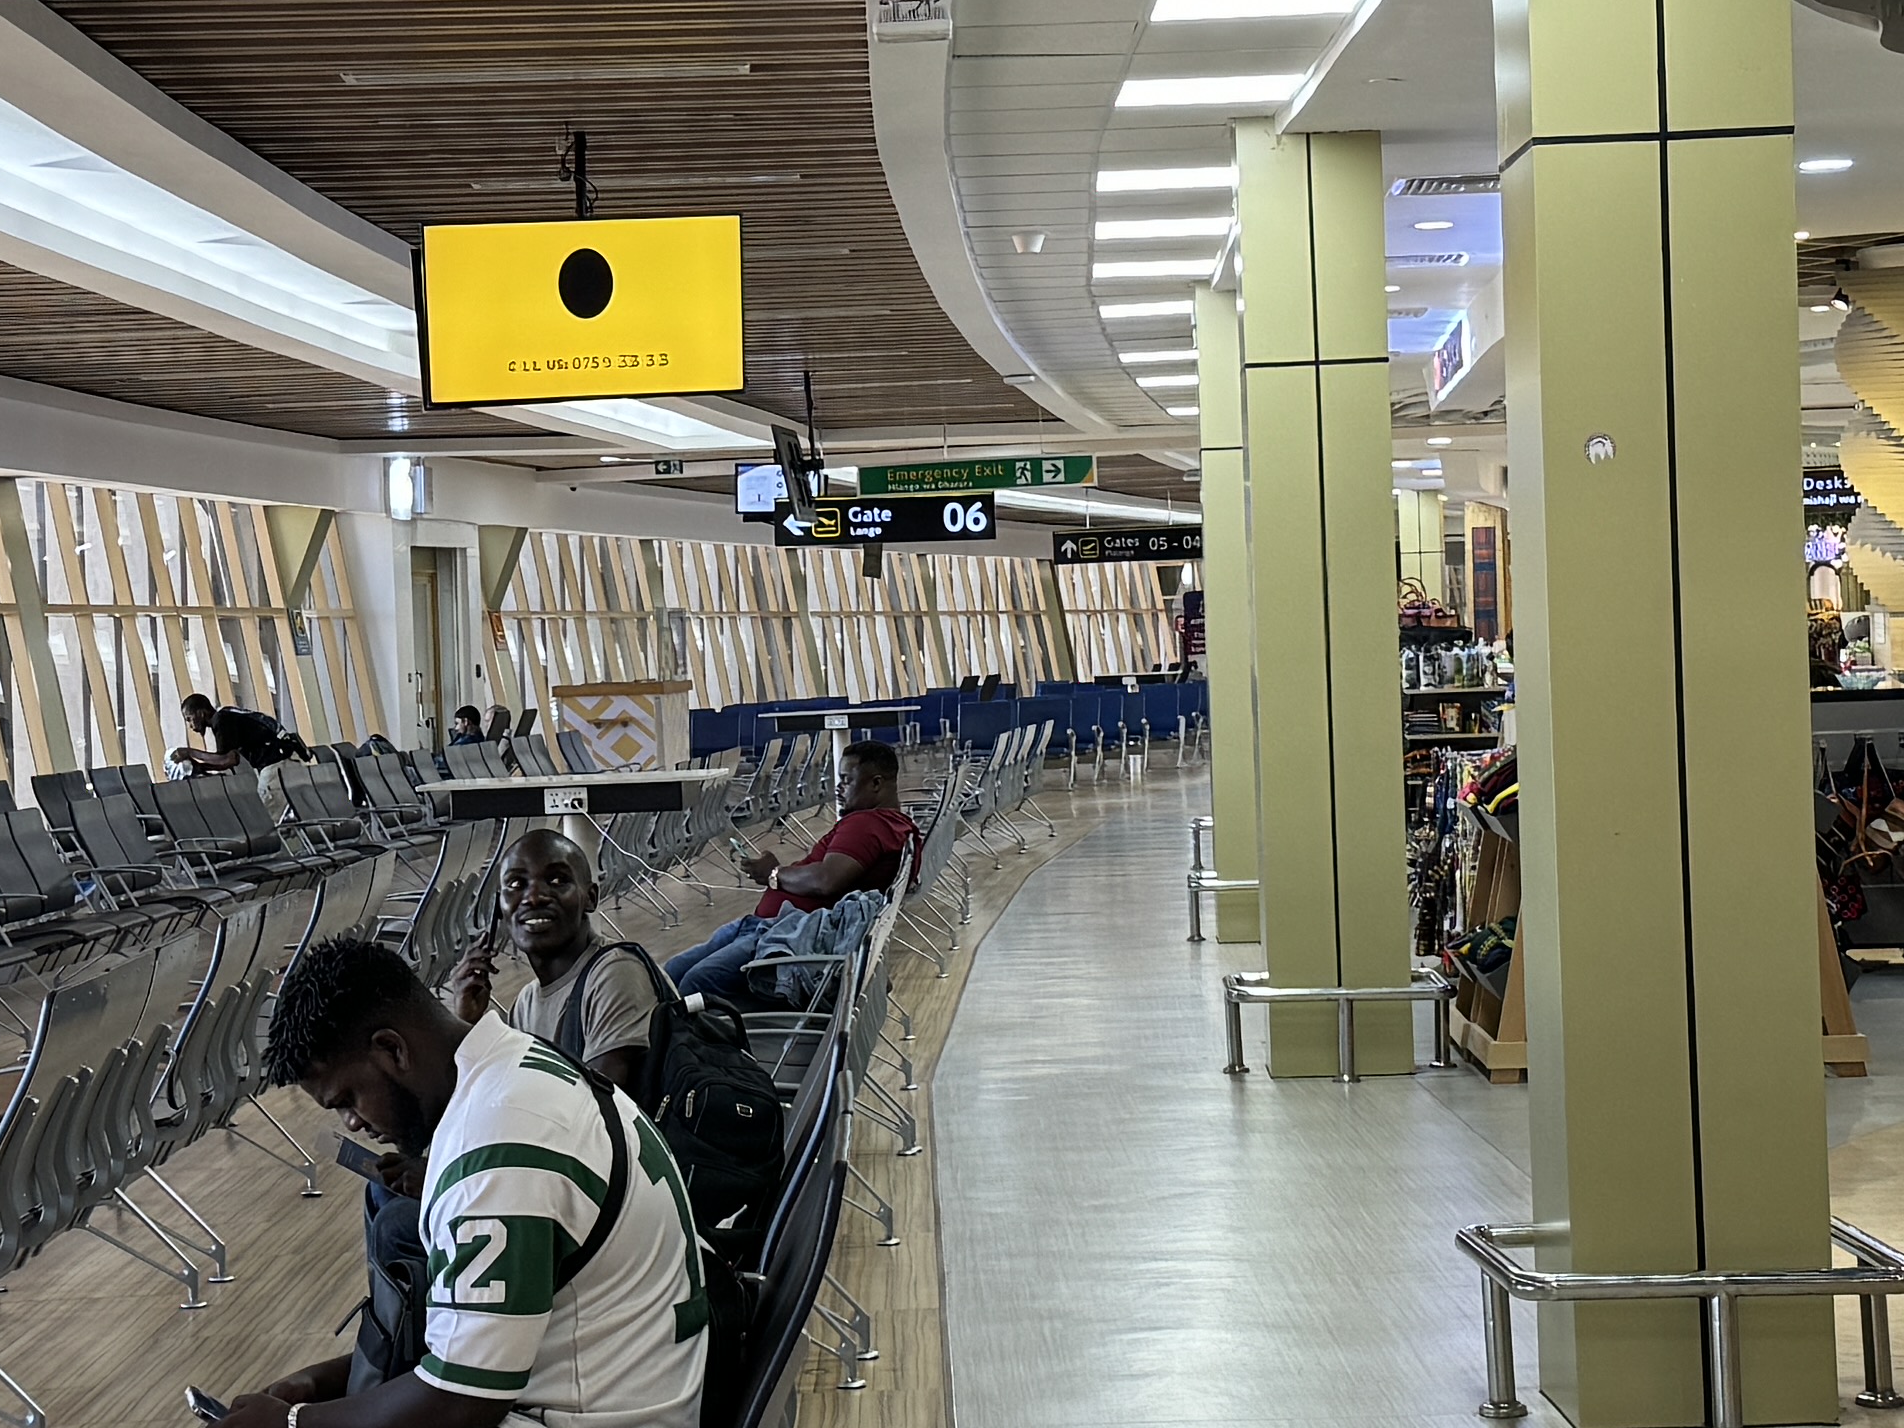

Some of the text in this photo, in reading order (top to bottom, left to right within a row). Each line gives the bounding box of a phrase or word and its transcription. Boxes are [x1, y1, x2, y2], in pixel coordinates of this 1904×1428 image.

[887, 463, 1005, 484] Emergency Exit
[847, 501, 988, 533] Gate 06
[849, 524, 882, 538] Lango
[1104, 536, 1140, 548] Gates
[1149, 537, 1168, 550] 05
[1182, 535, 1201, 549] 04
[431, 1217, 508, 1304] 12
